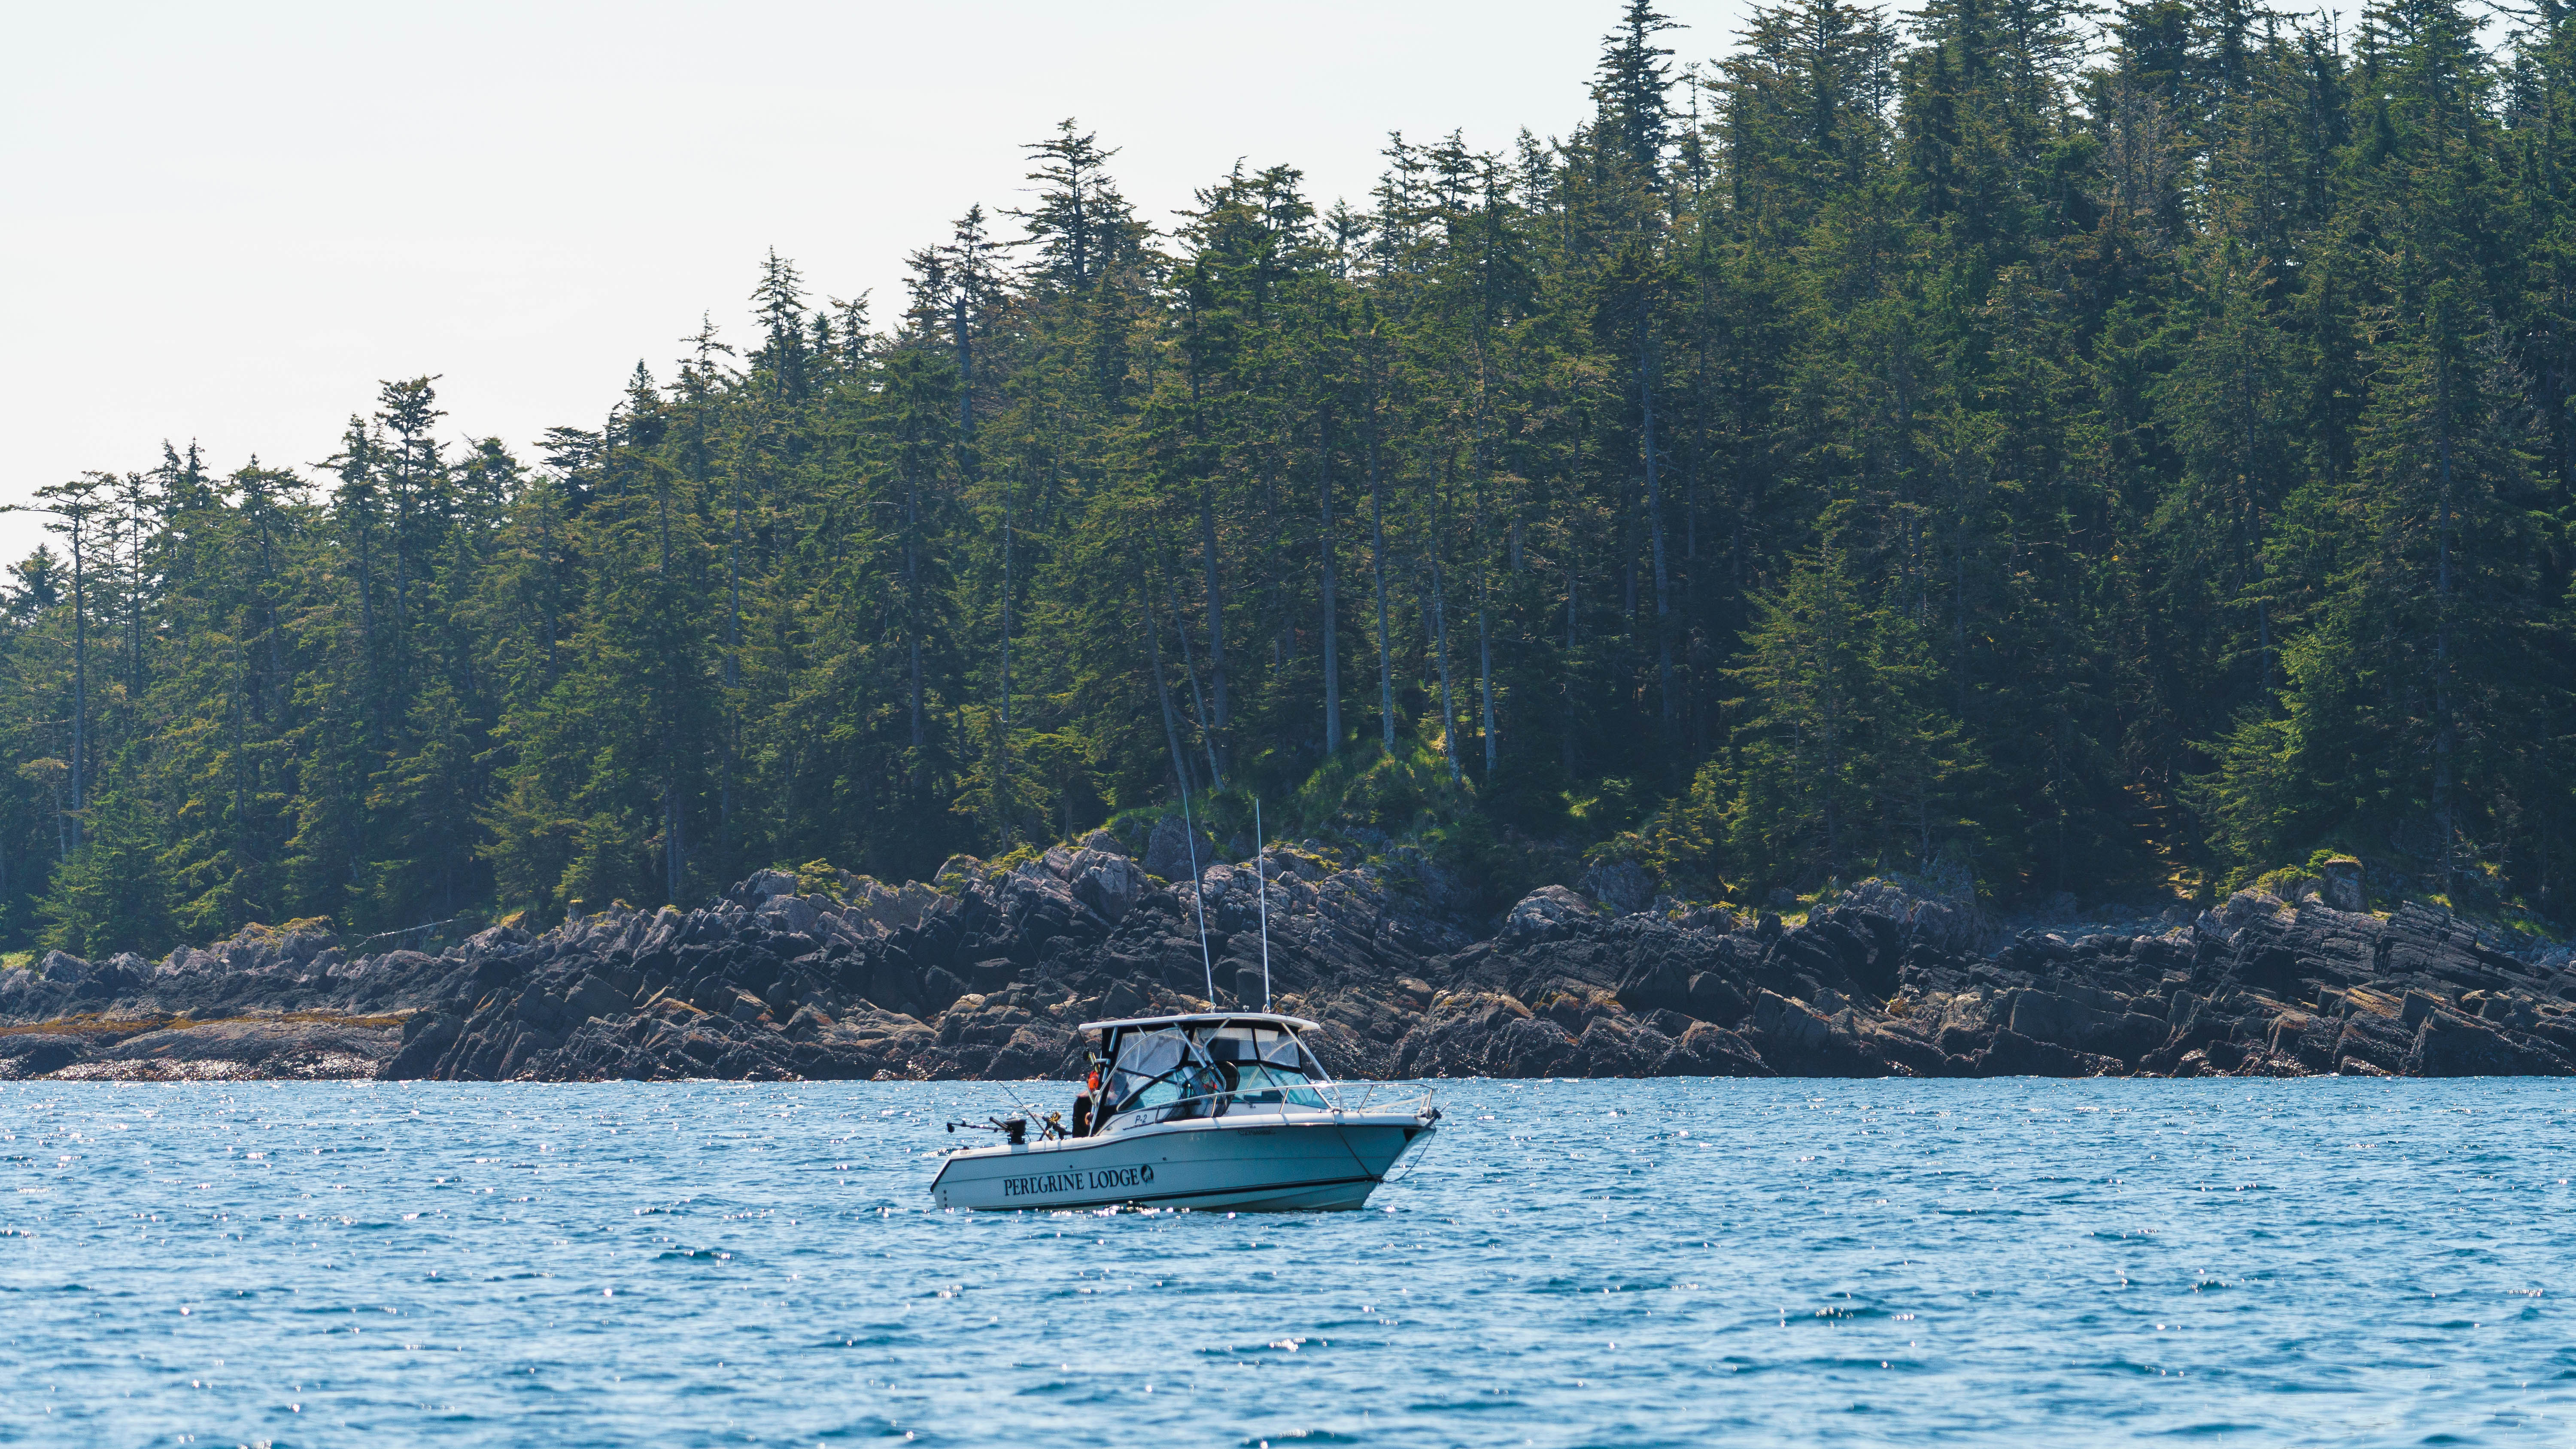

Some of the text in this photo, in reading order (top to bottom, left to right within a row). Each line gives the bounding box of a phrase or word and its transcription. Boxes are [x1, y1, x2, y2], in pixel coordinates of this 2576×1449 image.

[1135, 1114, 1147, 1124] P-2
[1003, 1168, 1139, 1196] PEREGRINE LODGE
